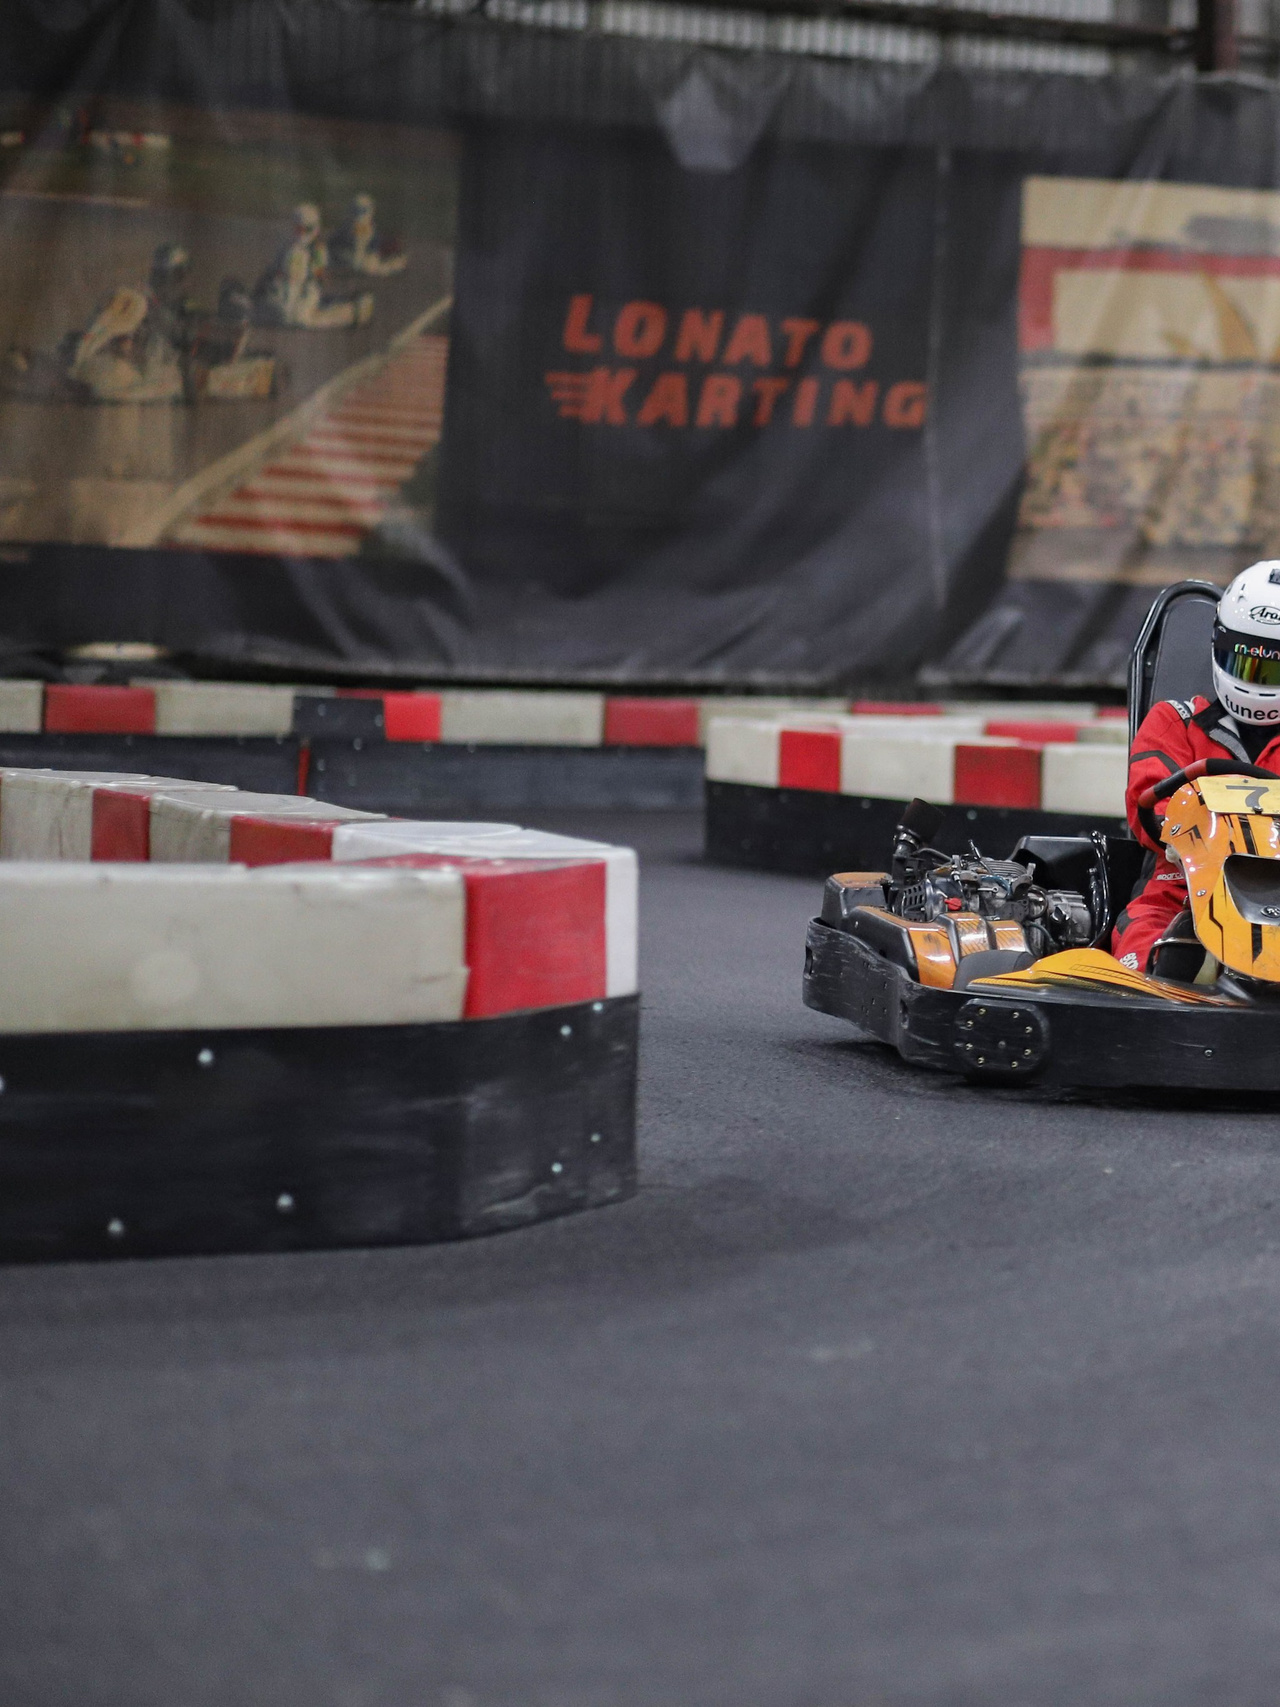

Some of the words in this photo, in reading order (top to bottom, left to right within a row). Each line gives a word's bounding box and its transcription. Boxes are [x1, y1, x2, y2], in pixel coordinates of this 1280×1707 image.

[562, 294, 874, 370] LONATO
[572, 366, 929, 429] KARTING
[1225, 785, 1270, 809] 7
